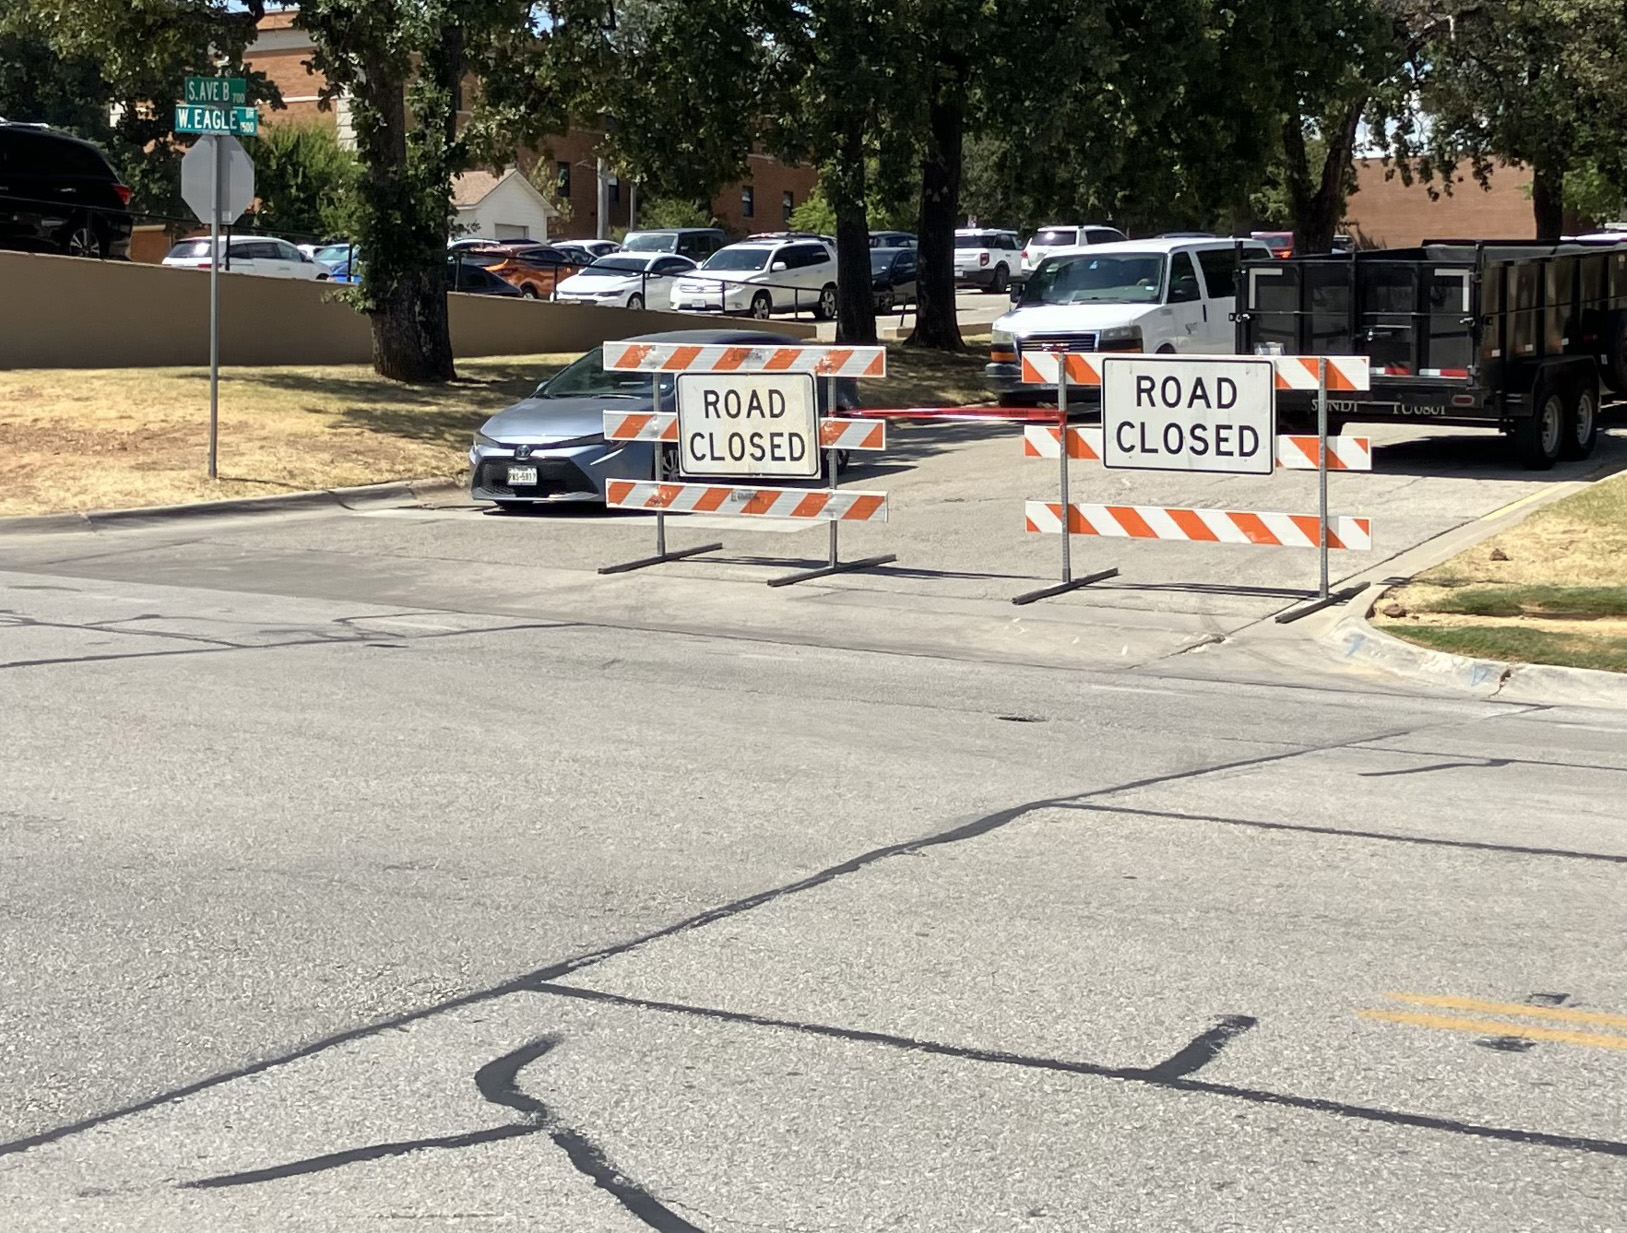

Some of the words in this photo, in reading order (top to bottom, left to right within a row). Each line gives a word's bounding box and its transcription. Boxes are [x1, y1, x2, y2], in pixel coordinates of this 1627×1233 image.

[222, 82, 229, 101] B
[178, 109, 191, 128] W.
[194, 110, 238, 129] EAGLE
[703, 388, 786, 419] ROAD
[1136, 374, 1238, 410] ROAD
[1311, 398, 1358, 413] SNDT
[689, 432, 806, 462] CLOSED
[1115, 420, 1260, 459] CLOSED
